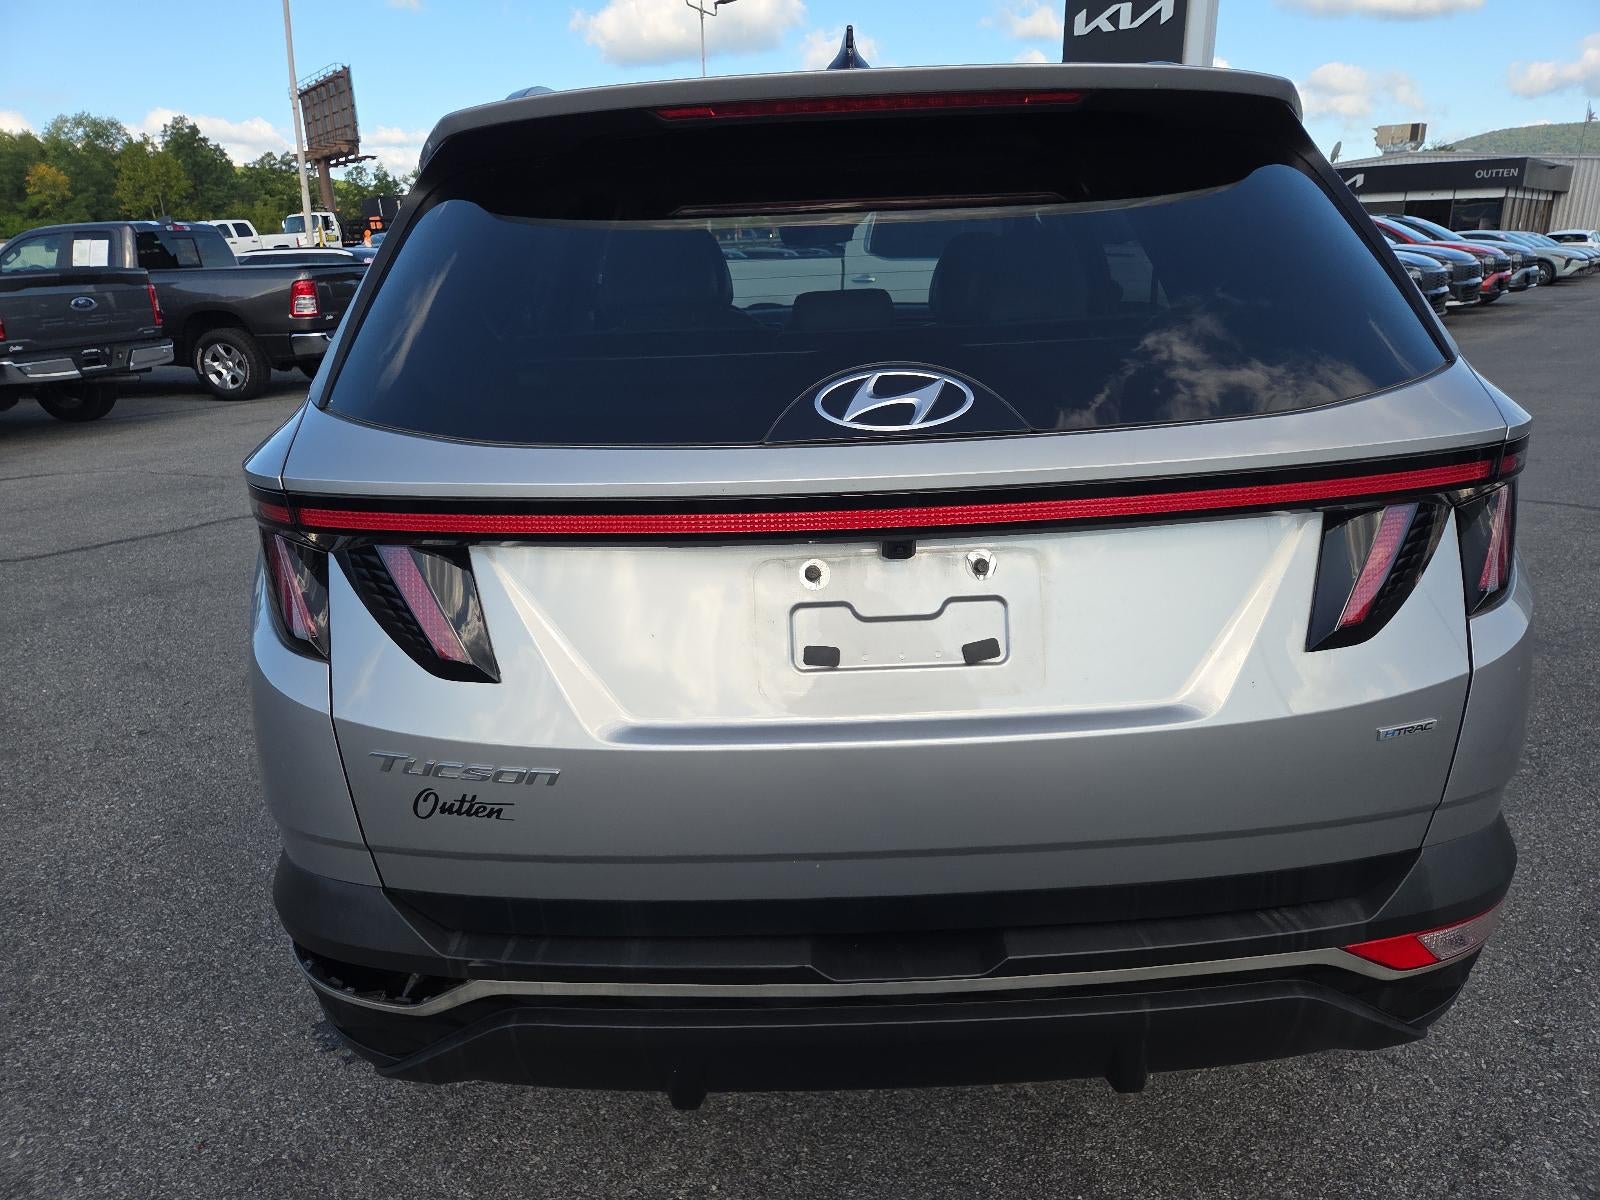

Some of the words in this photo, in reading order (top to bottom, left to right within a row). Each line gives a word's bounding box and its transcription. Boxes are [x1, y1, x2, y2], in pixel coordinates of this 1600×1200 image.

[1074, 0, 1174, 36] KIA
[1475, 168, 1518, 179] OUTTEN
[1382, 720, 1435, 738] HTRAC
[412, 787, 515, 820] Outten
